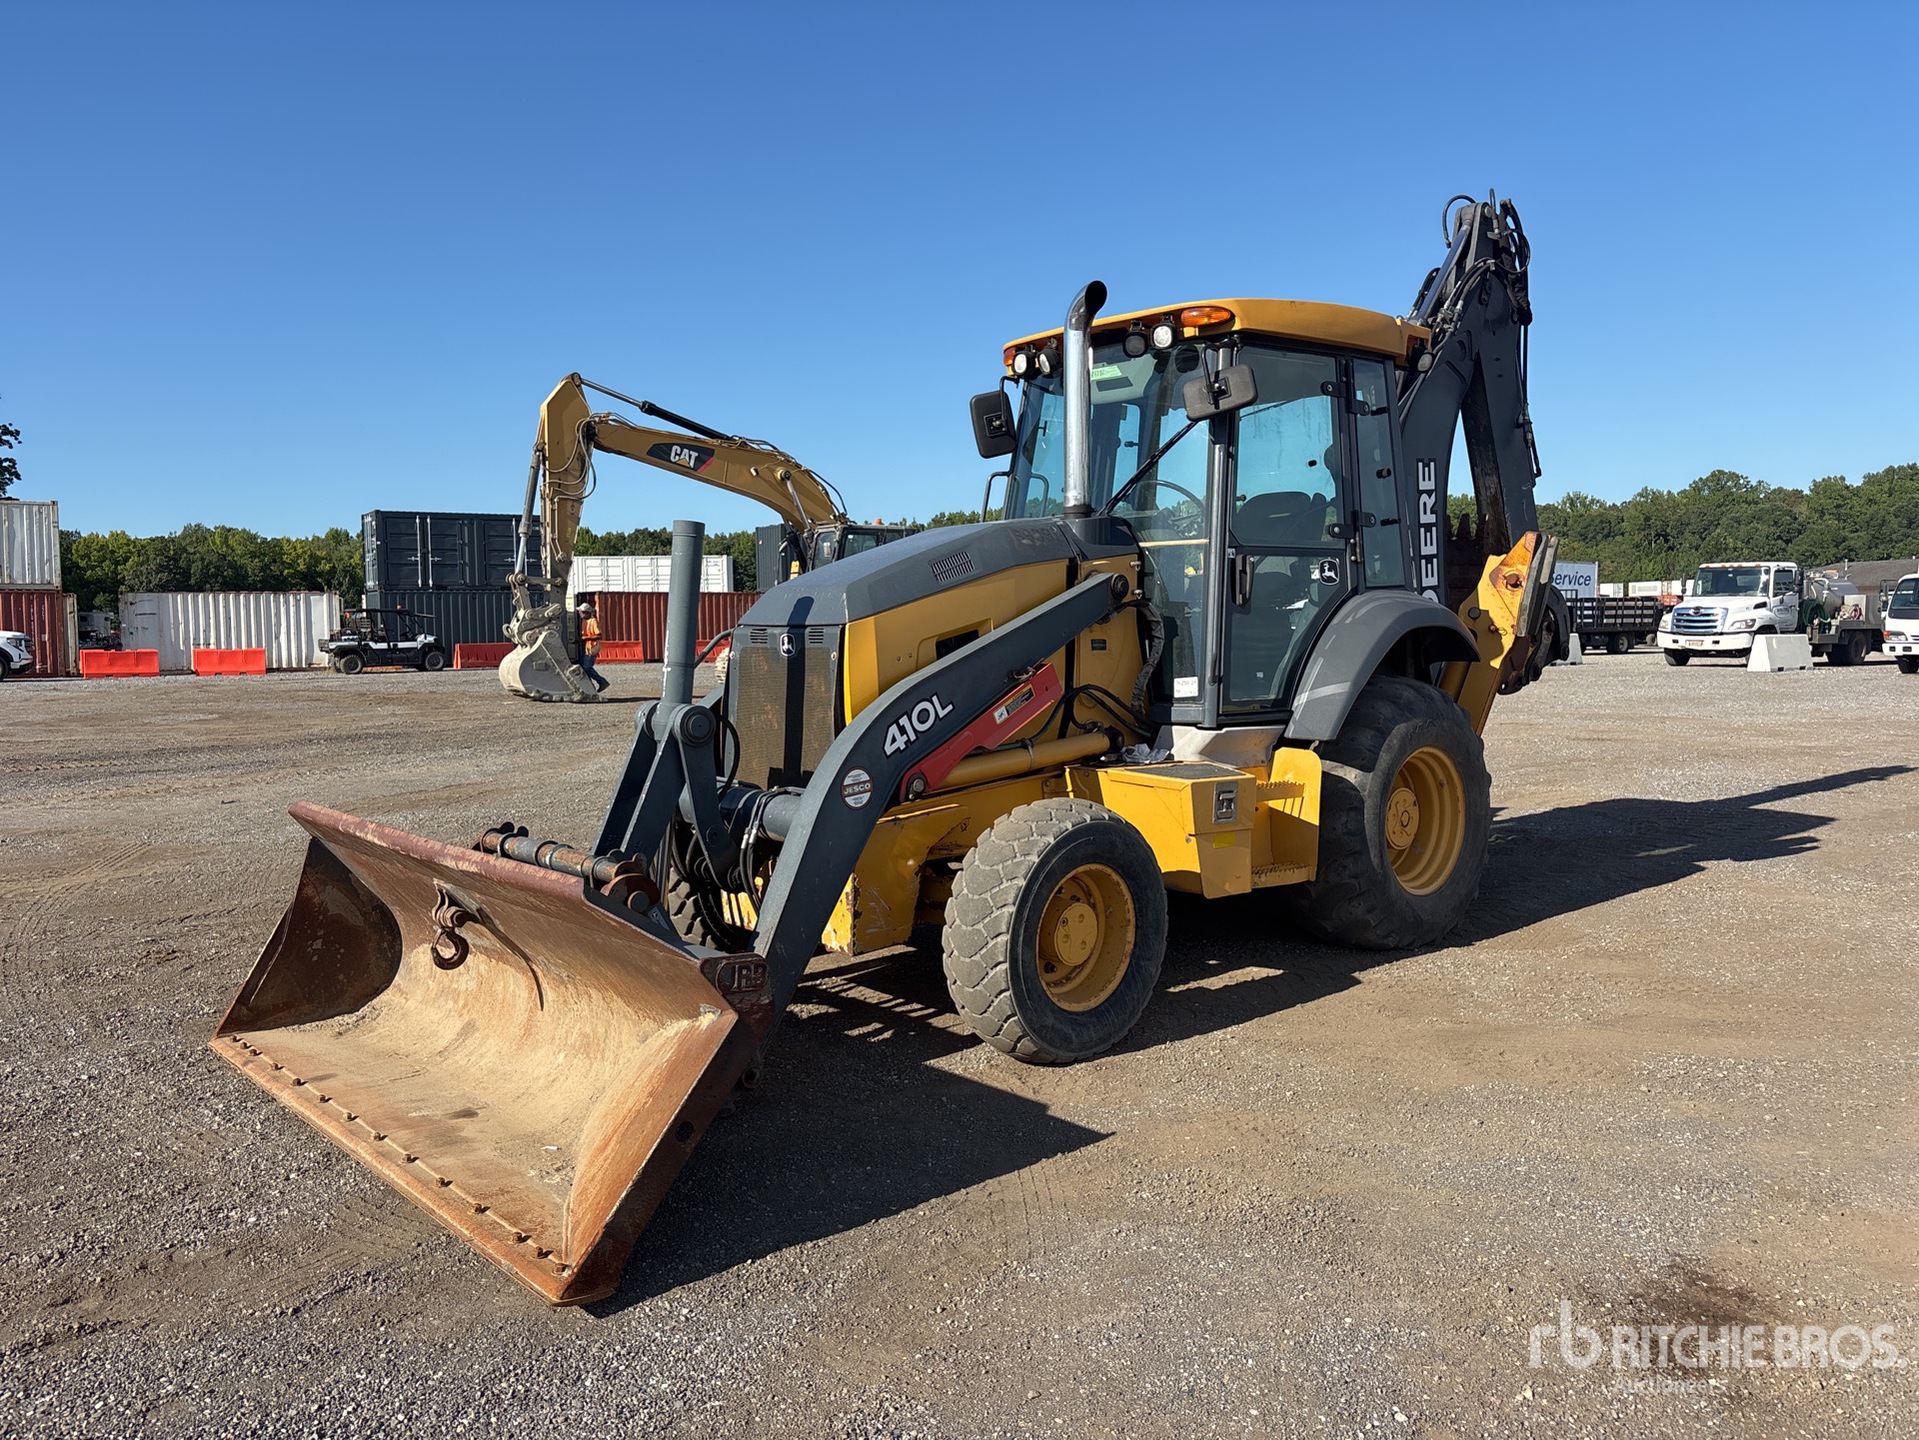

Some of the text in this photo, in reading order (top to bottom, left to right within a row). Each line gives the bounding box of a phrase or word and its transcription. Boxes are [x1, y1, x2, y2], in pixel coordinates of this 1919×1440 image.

[670, 445, 699, 469] CAT
[1552, 571, 1592, 587] ervice
[884, 695, 954, 756] 410L
[843, 782, 871, 795] JESCO
